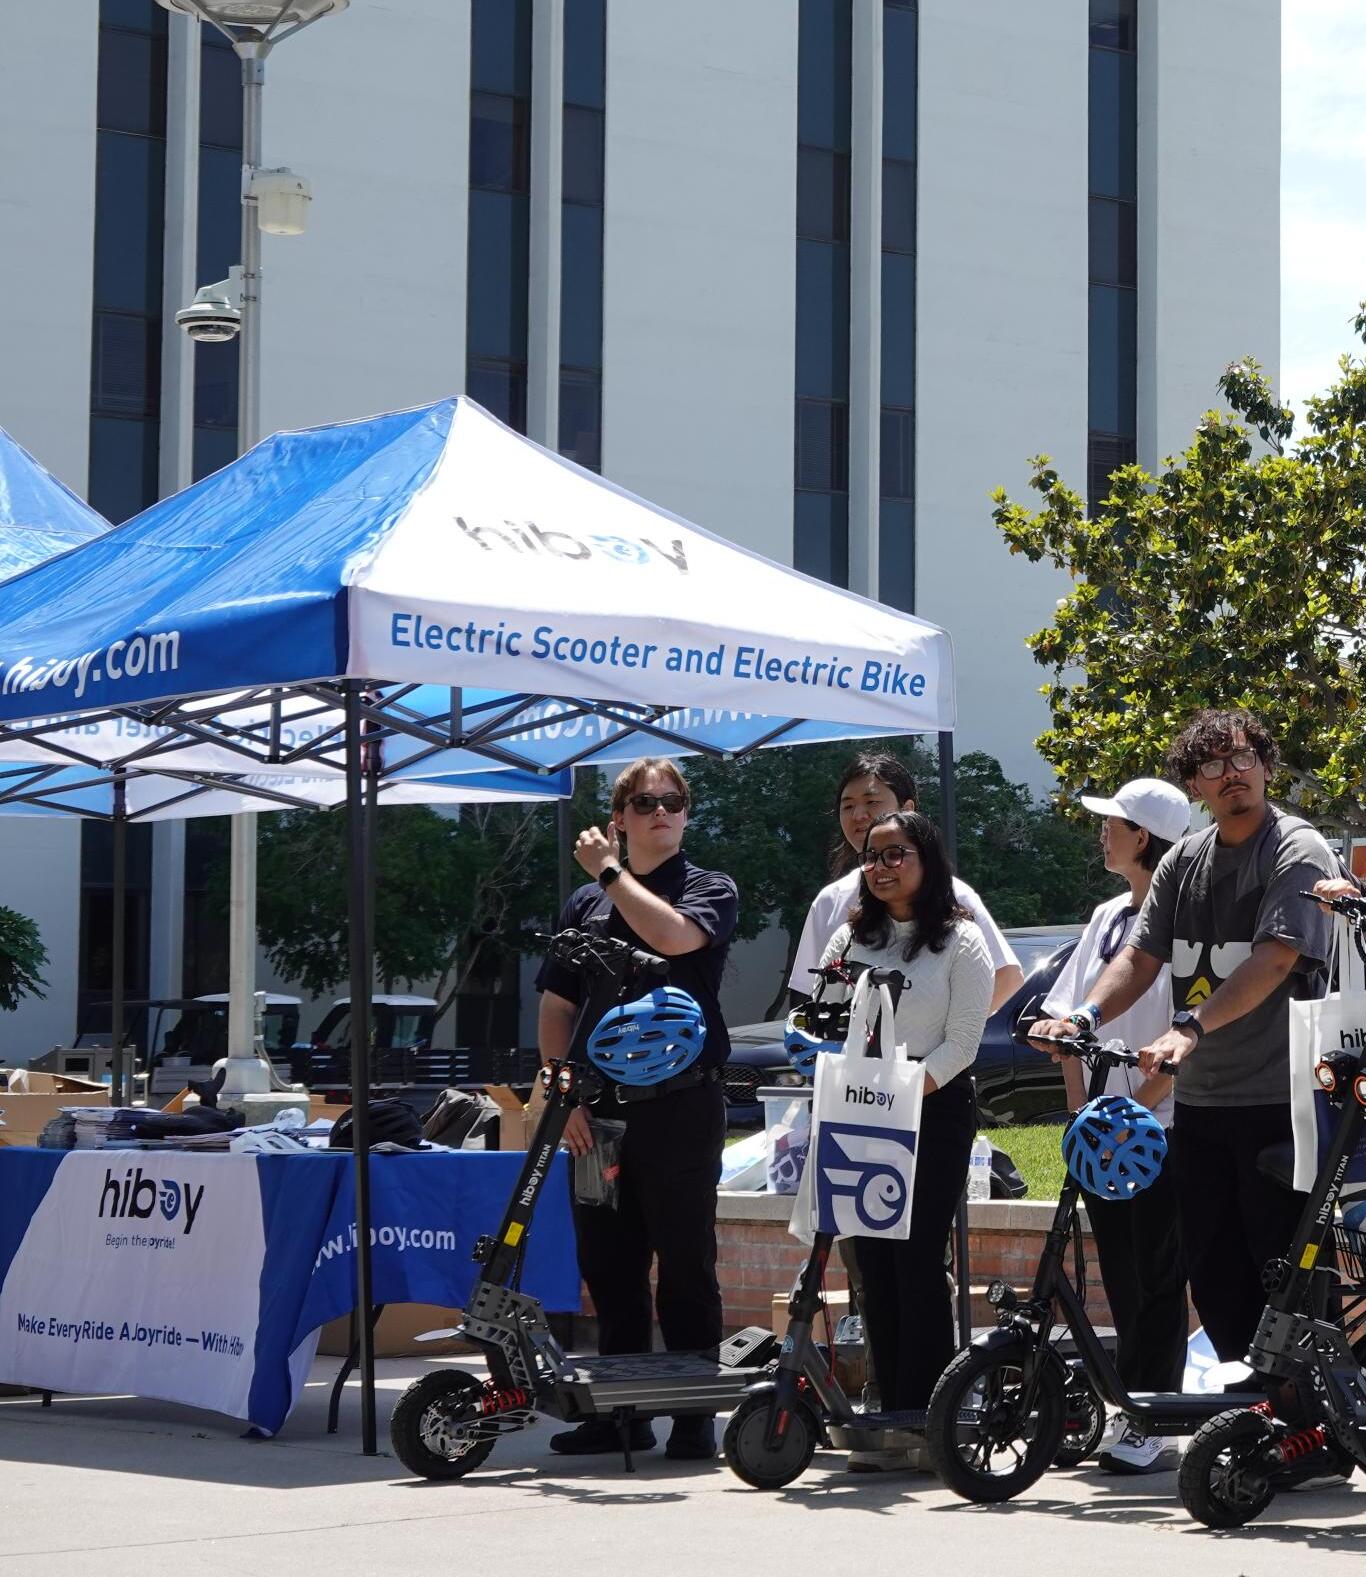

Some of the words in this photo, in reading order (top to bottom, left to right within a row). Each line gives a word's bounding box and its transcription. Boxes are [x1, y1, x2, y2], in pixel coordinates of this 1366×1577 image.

[454, 516, 689, 575] hiboy
[391, 612, 522, 657] Electric
[530, 626, 658, 669] Scooter
[665, 644, 725, 676] and
[733, 646, 853, 689] Electric
[860, 660, 926, 697] Bike
[845, 1084, 896, 1111] hiboy
[98, 1167, 205, 1235] hiboy
[519, 1168, 544, 1207] hiboy
[536, 1144, 551, 1168] TITAN
[1315, 1184, 1340, 1225] hiboy
[1334, 1154, 1350, 1183] TITAN
[105, 1234, 128, 1248] Begin
[131, 1235, 147, 1246] the
[18, 1313, 45, 1334] Make
[119, 1322, 130, 1341] A
